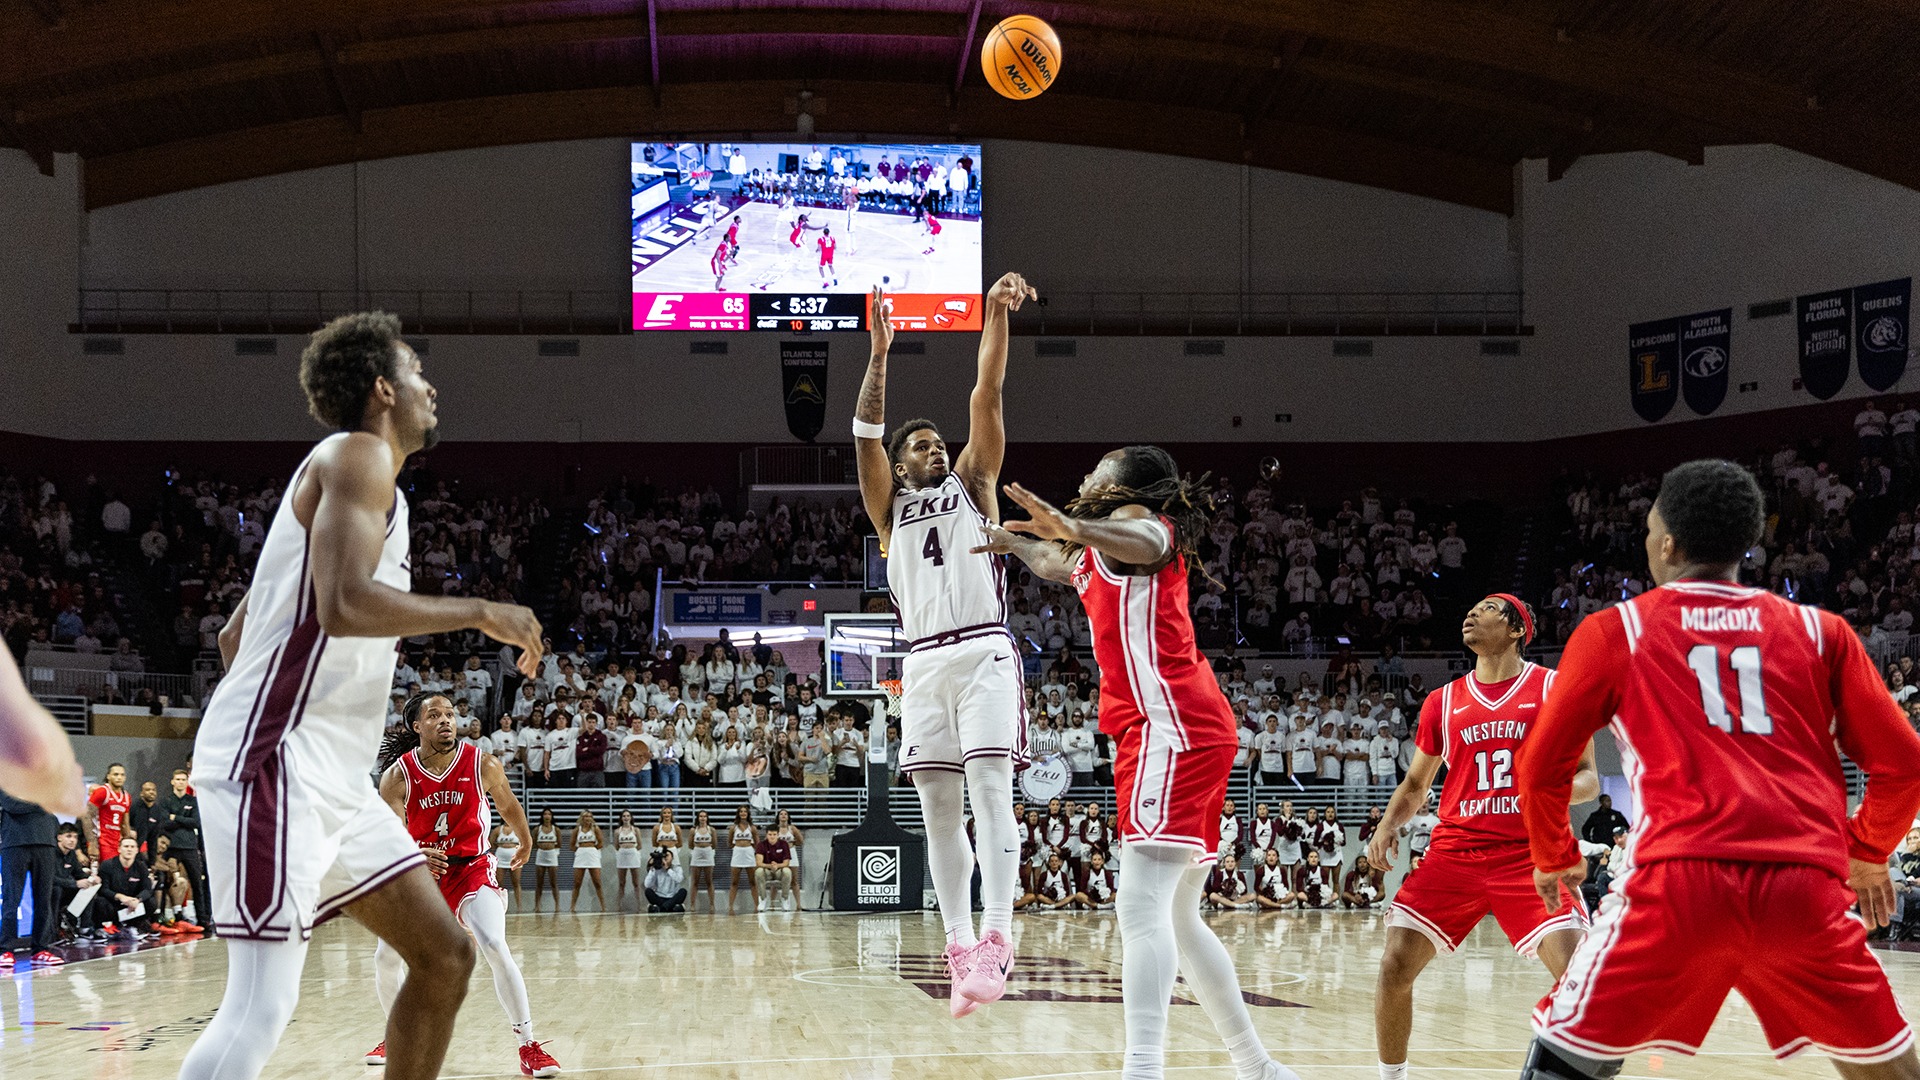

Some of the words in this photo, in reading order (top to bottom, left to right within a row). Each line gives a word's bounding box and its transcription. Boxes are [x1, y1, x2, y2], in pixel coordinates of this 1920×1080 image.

[1021, 37, 1052, 85] Wilson
[1005, 64, 1032, 94] NCAA
[723, 297, 745, 313] 65
[789, 297, 828, 314] 5:37
[1809, 297, 1842, 311] NORTH
[1862, 295, 1902, 312] QUEENS
[1691, 316, 1721, 328] NORTH
[1805, 307, 1846, 322] FLORIDA
[790, 320, 803, 330] 10
[810, 320, 833, 330] 2ND
[1684, 324, 1728, 340] ALABAMA
[1631, 332, 1676, 348] LIPSCOMB
[1811, 329, 1839, 342] NORTH
[783, 359, 825, 367] CONFERENCE
[1638, 352, 1670, 392] L
[900, 493, 959, 522] EKU
[922, 526, 944, 567] 4
[688, 596, 717, 604] BUCKLE
[722, 596, 745, 604] PHONE
[804, 601, 815, 610] EXIT
[706, 605, 717, 614] UP
[722, 605, 745, 614] DOWN
[1681, 606, 1763, 632] MURDIX
[1686, 644, 1773, 736] 11
[1460, 720, 1526, 745] WESTERN
[907, 745, 920, 757] E
[1033, 769, 1060, 780] EKU
[1474, 749, 1513, 791] 12
[419, 790, 464, 810] WESTERN
[1459, 794, 1520, 817] KENTUCK
[434, 812, 448, 837] 4
[861, 886, 897, 895] ELLIOT
[857, 896, 900, 904] SERVICES
